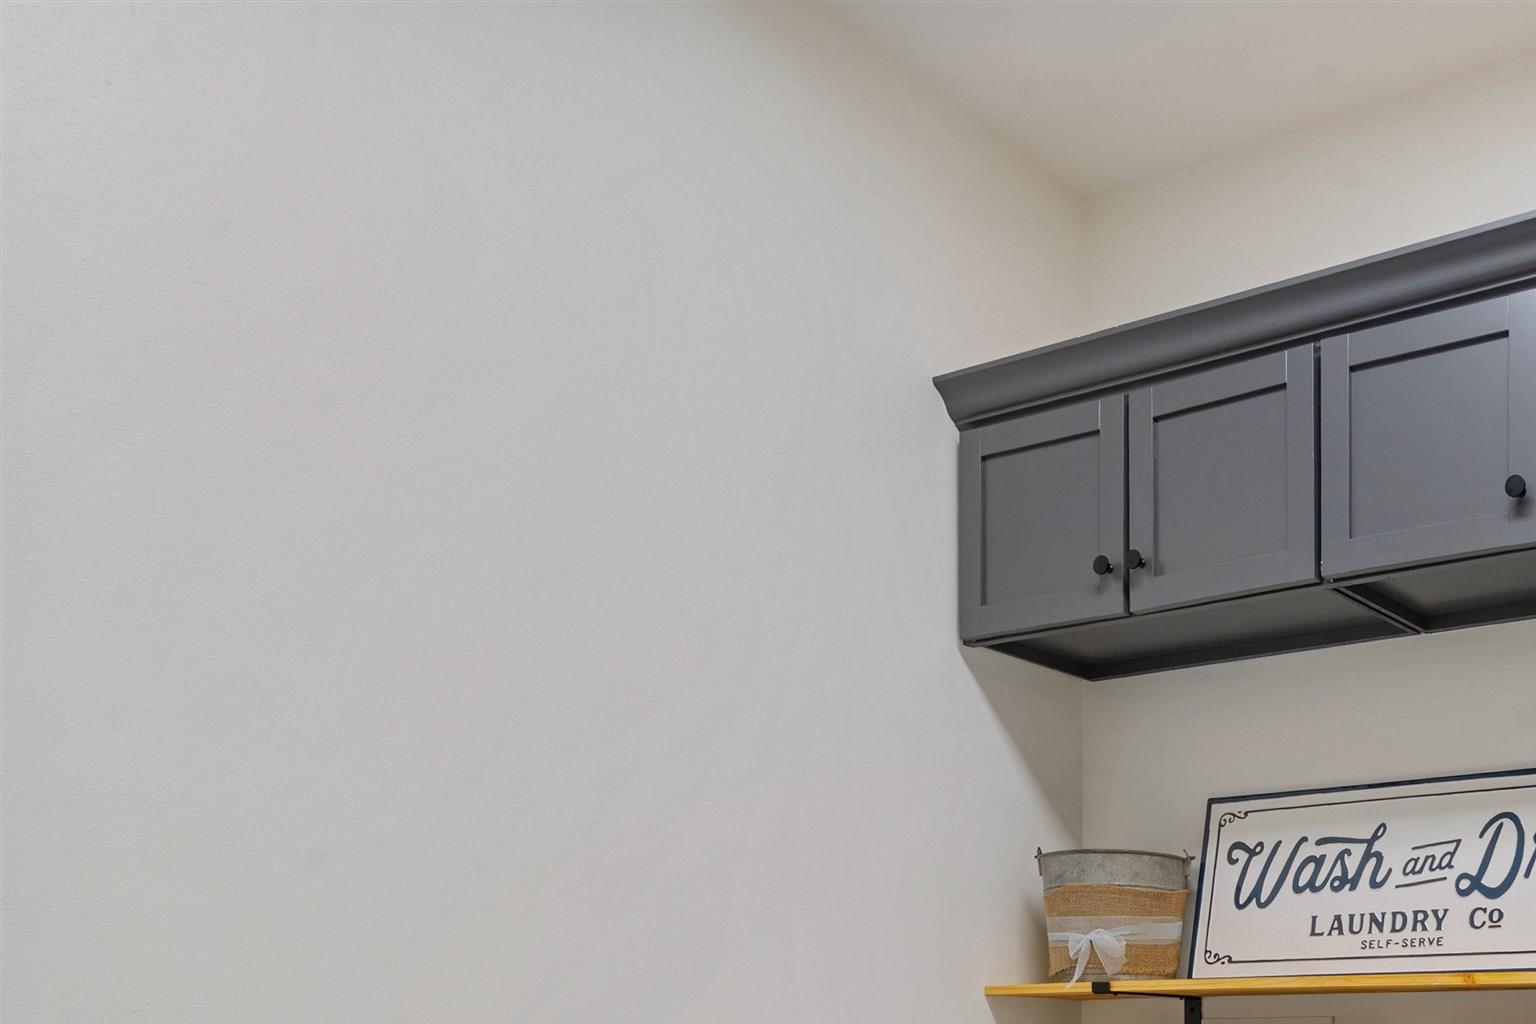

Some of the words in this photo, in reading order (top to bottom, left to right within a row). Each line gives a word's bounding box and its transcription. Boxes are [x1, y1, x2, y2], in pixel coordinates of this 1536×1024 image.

[1227, 822, 1392, 910] Wash
[1401, 839, 1461, 877] and
[1309, 908, 1449, 937] LAUNDRY
[1469, 907, 1504, 929] Co
[1360, 937, 1444, 950] SELF-SERVE
